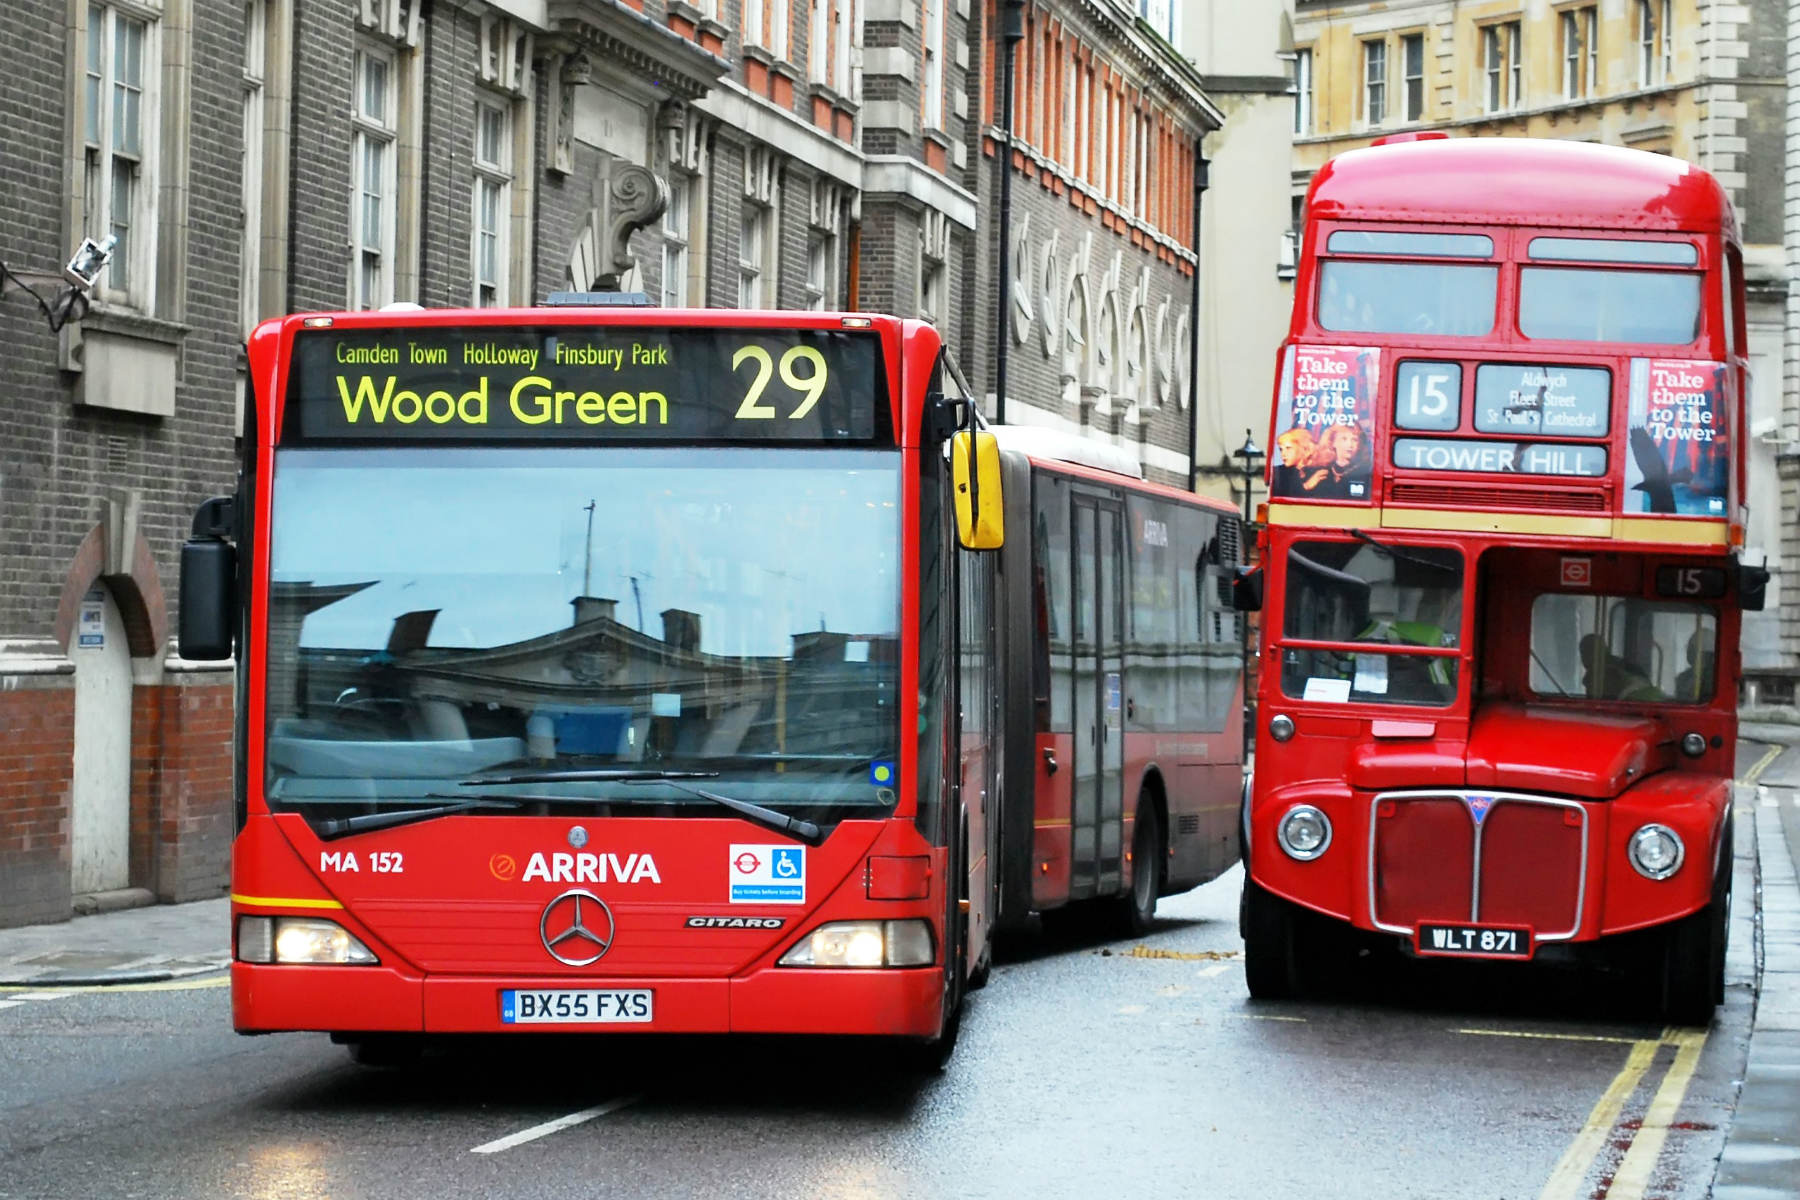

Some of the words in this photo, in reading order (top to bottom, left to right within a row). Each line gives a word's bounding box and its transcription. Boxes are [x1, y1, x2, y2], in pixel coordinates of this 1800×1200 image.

[336, 342, 399, 364] Camden
[408, 343, 447, 364] Town
[463, 343, 539, 371] Holloway
[556, 343, 623, 371] Finsbury
[632, 344, 668, 365] Park
[1297, 356, 1348, 374] Take
[732, 344, 828, 419] 29
[1296, 373, 1350, 392] them
[1521, 371, 1568, 394] Aldwych
[1652, 369, 1704, 388] Take
[336, 375, 488, 424] Wood
[509, 375, 668, 425] Green
[1295, 393, 1318, 408] to
[1322, 391, 1357, 409] the
[1409, 374, 1449, 417] 15
[1543, 392, 1577, 408] Street
[1652, 388, 1706, 406] them
[1294, 408, 1359, 427] Tower
[1545, 411, 1598, 428] Cathedral
[1651, 407, 1674, 422] to
[1677, 406, 1713, 424] the
[1649, 421, 1716, 442] Tower
[1409, 445, 1516, 472] TOWER
[1529, 450, 1593, 476] HILL
[1676, 568, 1703, 595] 15
[320, 851, 360, 873] MA
[369, 851, 404, 873] 152
[521, 851, 662, 884] ARRIVA
[688, 917, 782, 929] CITARO
[1432, 928, 1476, 950] WLT
[1480, 930, 1517, 951] 871
[520, 993, 589, 1018] BX55
[597, 993, 648, 1017] FXS
